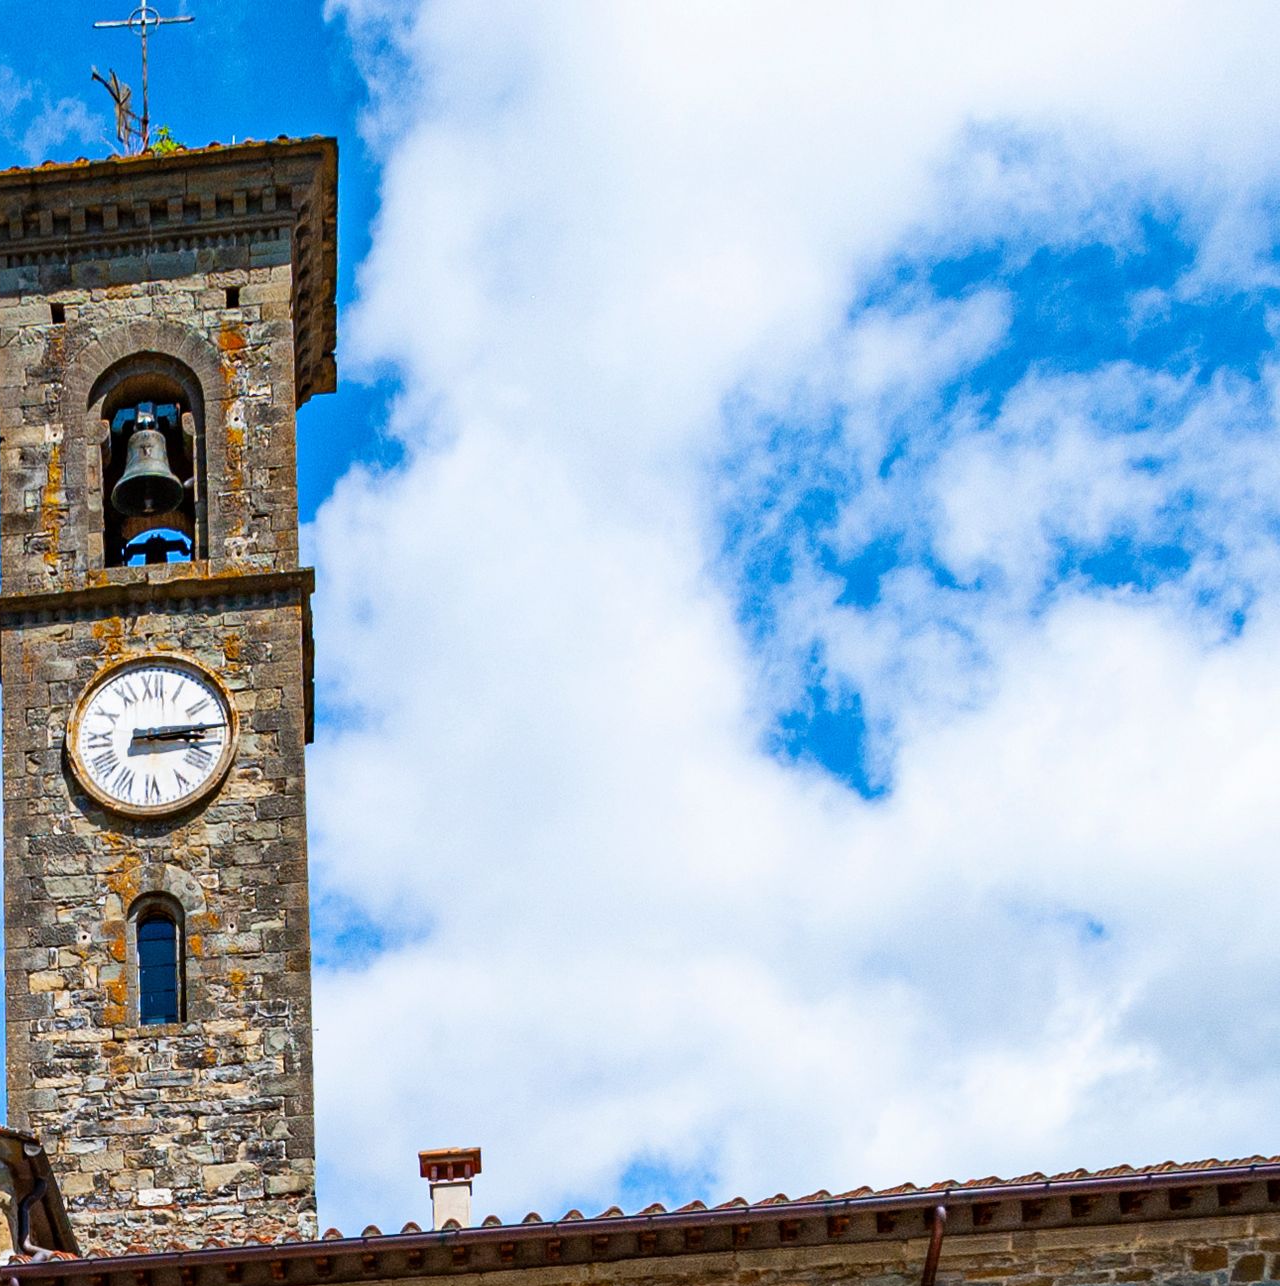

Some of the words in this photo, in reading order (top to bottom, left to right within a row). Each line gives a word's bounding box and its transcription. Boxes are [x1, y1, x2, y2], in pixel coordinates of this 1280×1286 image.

[113, 681, 139, 708] XI
[141, 674, 164, 701] XII
[94, 705, 120, 725] X
[88, 730, 113, 748] IX
[112, 766, 136, 796] VII
[145, 773, 160, 798] VI
[173, 768, 190, 789] V
